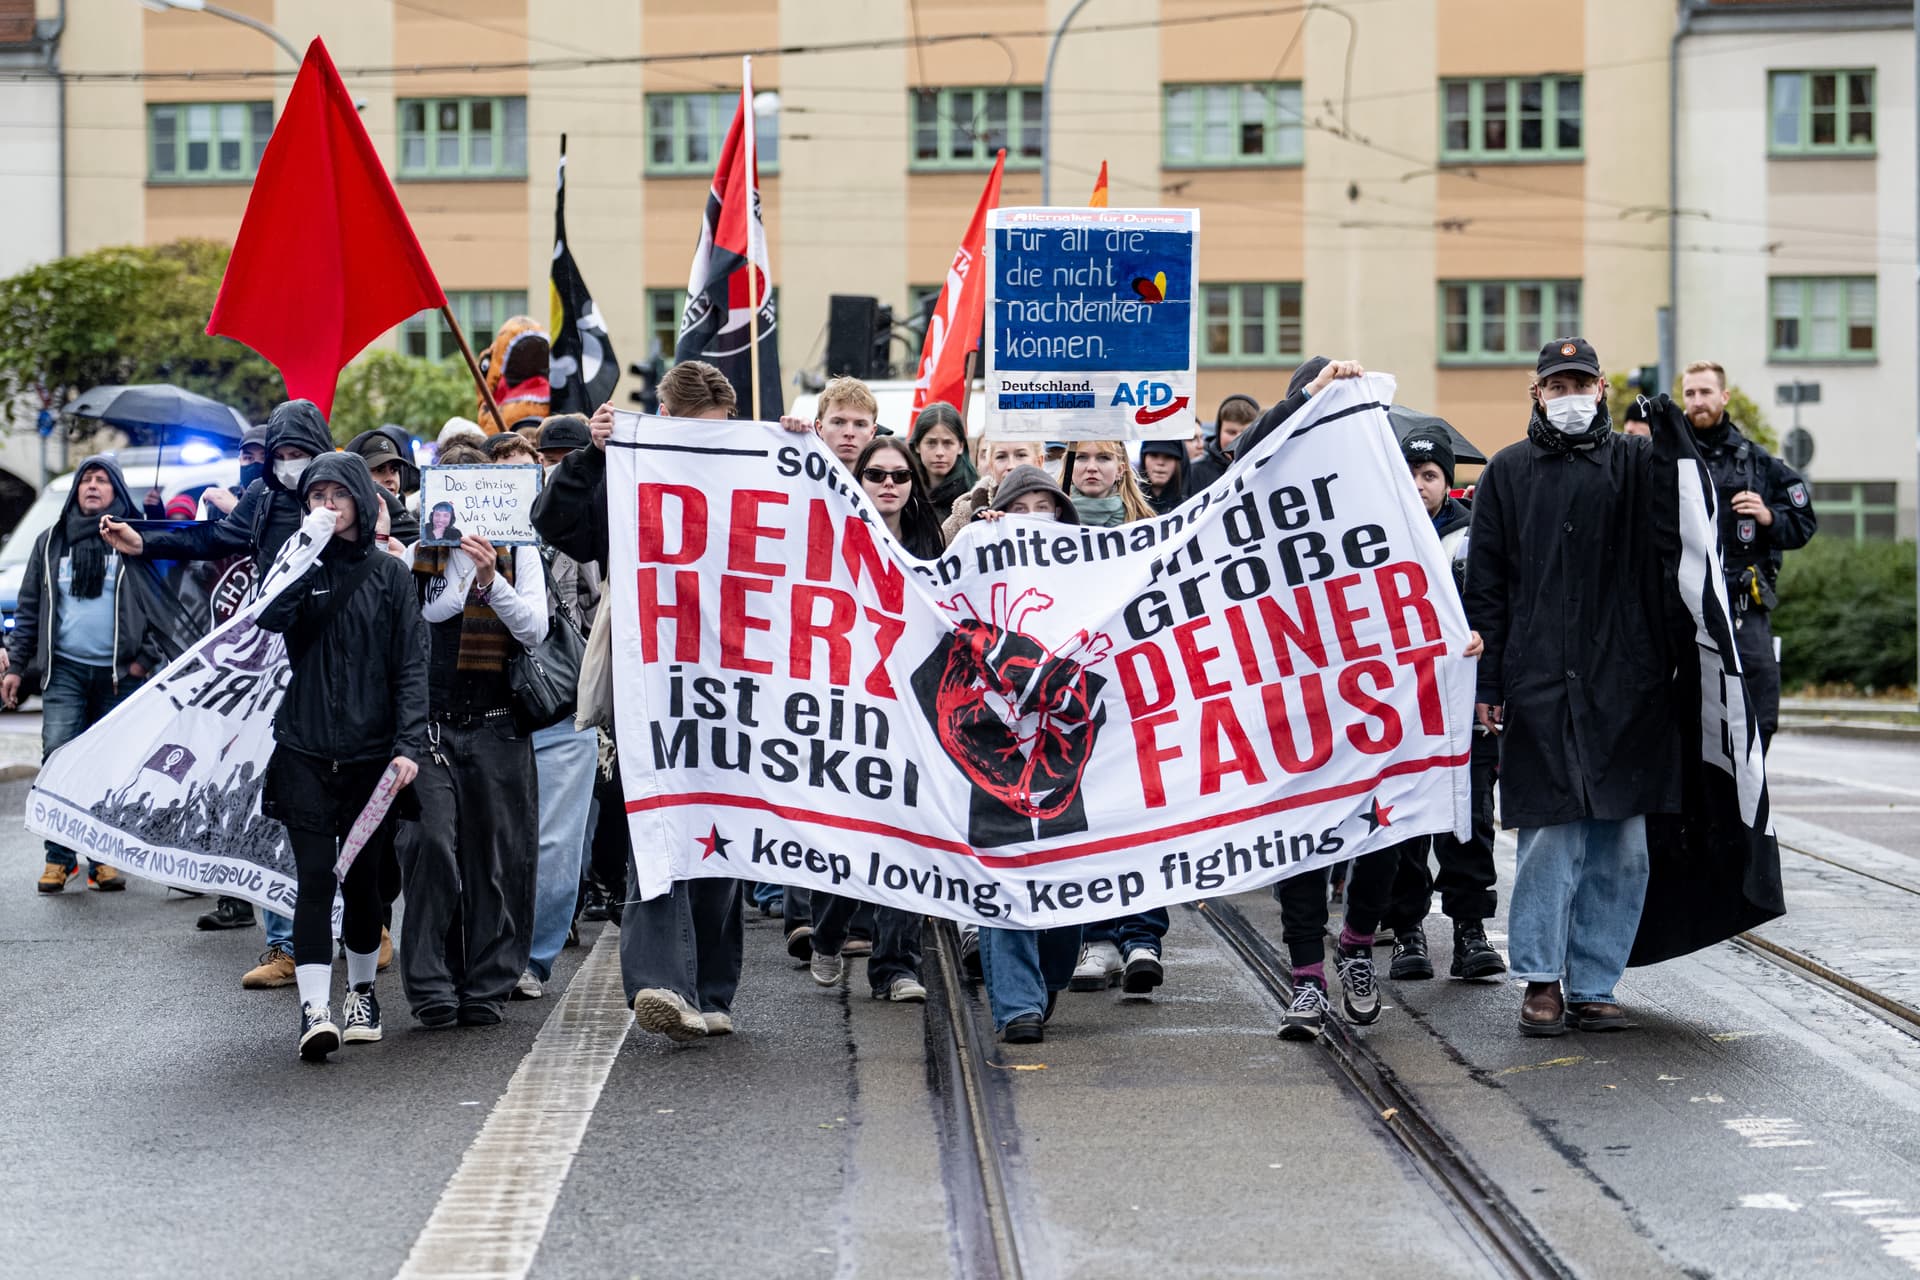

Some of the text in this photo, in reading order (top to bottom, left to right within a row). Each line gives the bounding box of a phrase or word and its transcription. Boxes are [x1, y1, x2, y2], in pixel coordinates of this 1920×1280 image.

[1061, 225, 1088, 251] all
[1006, 256, 1117, 287] die nicht
[1007, 292, 1153, 324] nachdenken
[1006, 328, 1108, 359] können.
[1002, 380, 1094, 392] Deutschland.
[1110, 380, 1173, 406] AfD
[444, 475, 518, 495] Das einzige
[465, 496, 503, 509] BLAU
[1221, 473, 1339, 548] der
[460, 511, 486, 523] Was
[637, 482, 905, 616] DEIN
[1122, 523, 1391, 640] Größe
[637, 567, 906, 701] HERZ
[1114, 560, 1442, 720] DEINER
[669, 664, 890, 750] ist ein
[1132, 642, 1447, 809] FAUST
[650, 718, 919, 808] Muskel
[751, 820, 1345, 920] keep loving, keep fighting
